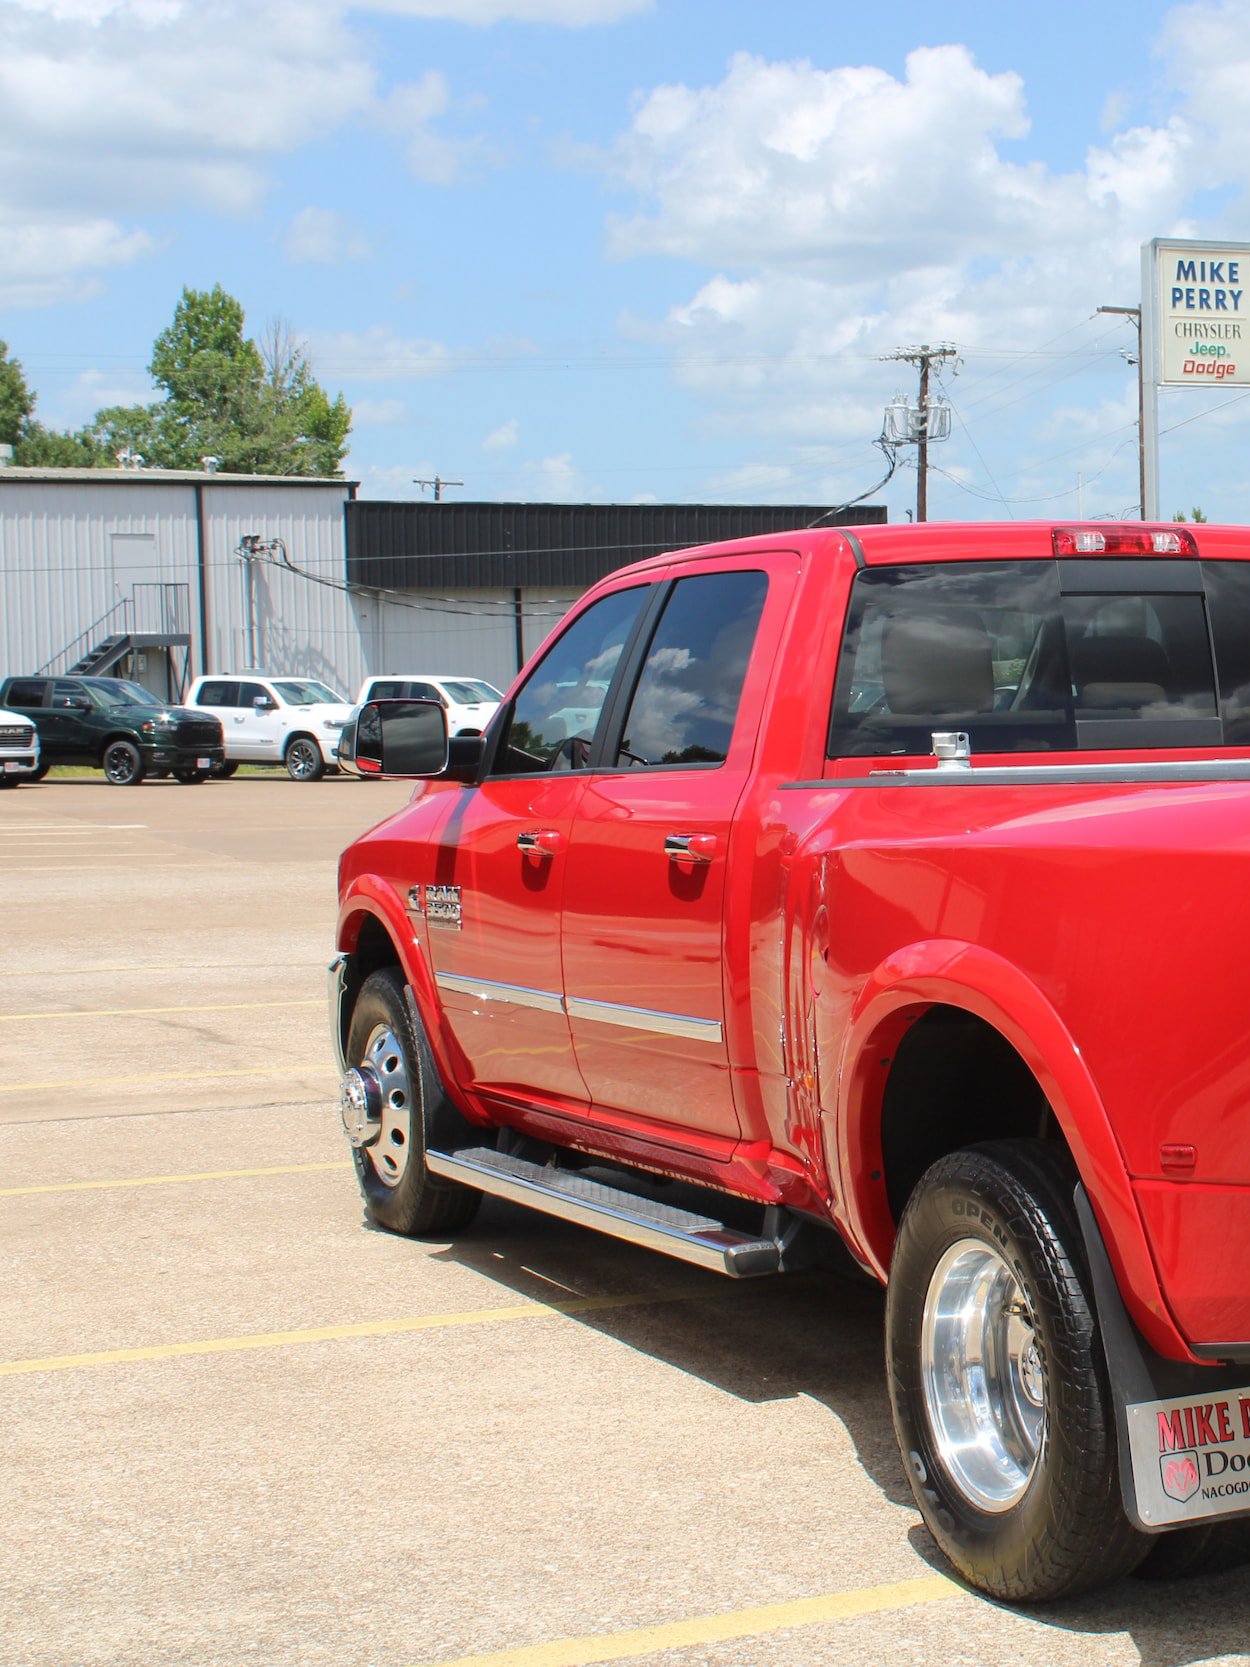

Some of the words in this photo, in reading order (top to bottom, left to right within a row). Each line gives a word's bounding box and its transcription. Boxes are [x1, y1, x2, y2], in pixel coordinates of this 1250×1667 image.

[1176, 260, 1239, 283] MIKE
[1171, 287, 1243, 311] PERRY
[1175, 322, 1241, 339] CHRYSLER
[1183, 360, 1236, 379] Dodge
[952, 1200, 1009, 1248] OPEN
[1156, 1401, 1235, 1453] MIKE
